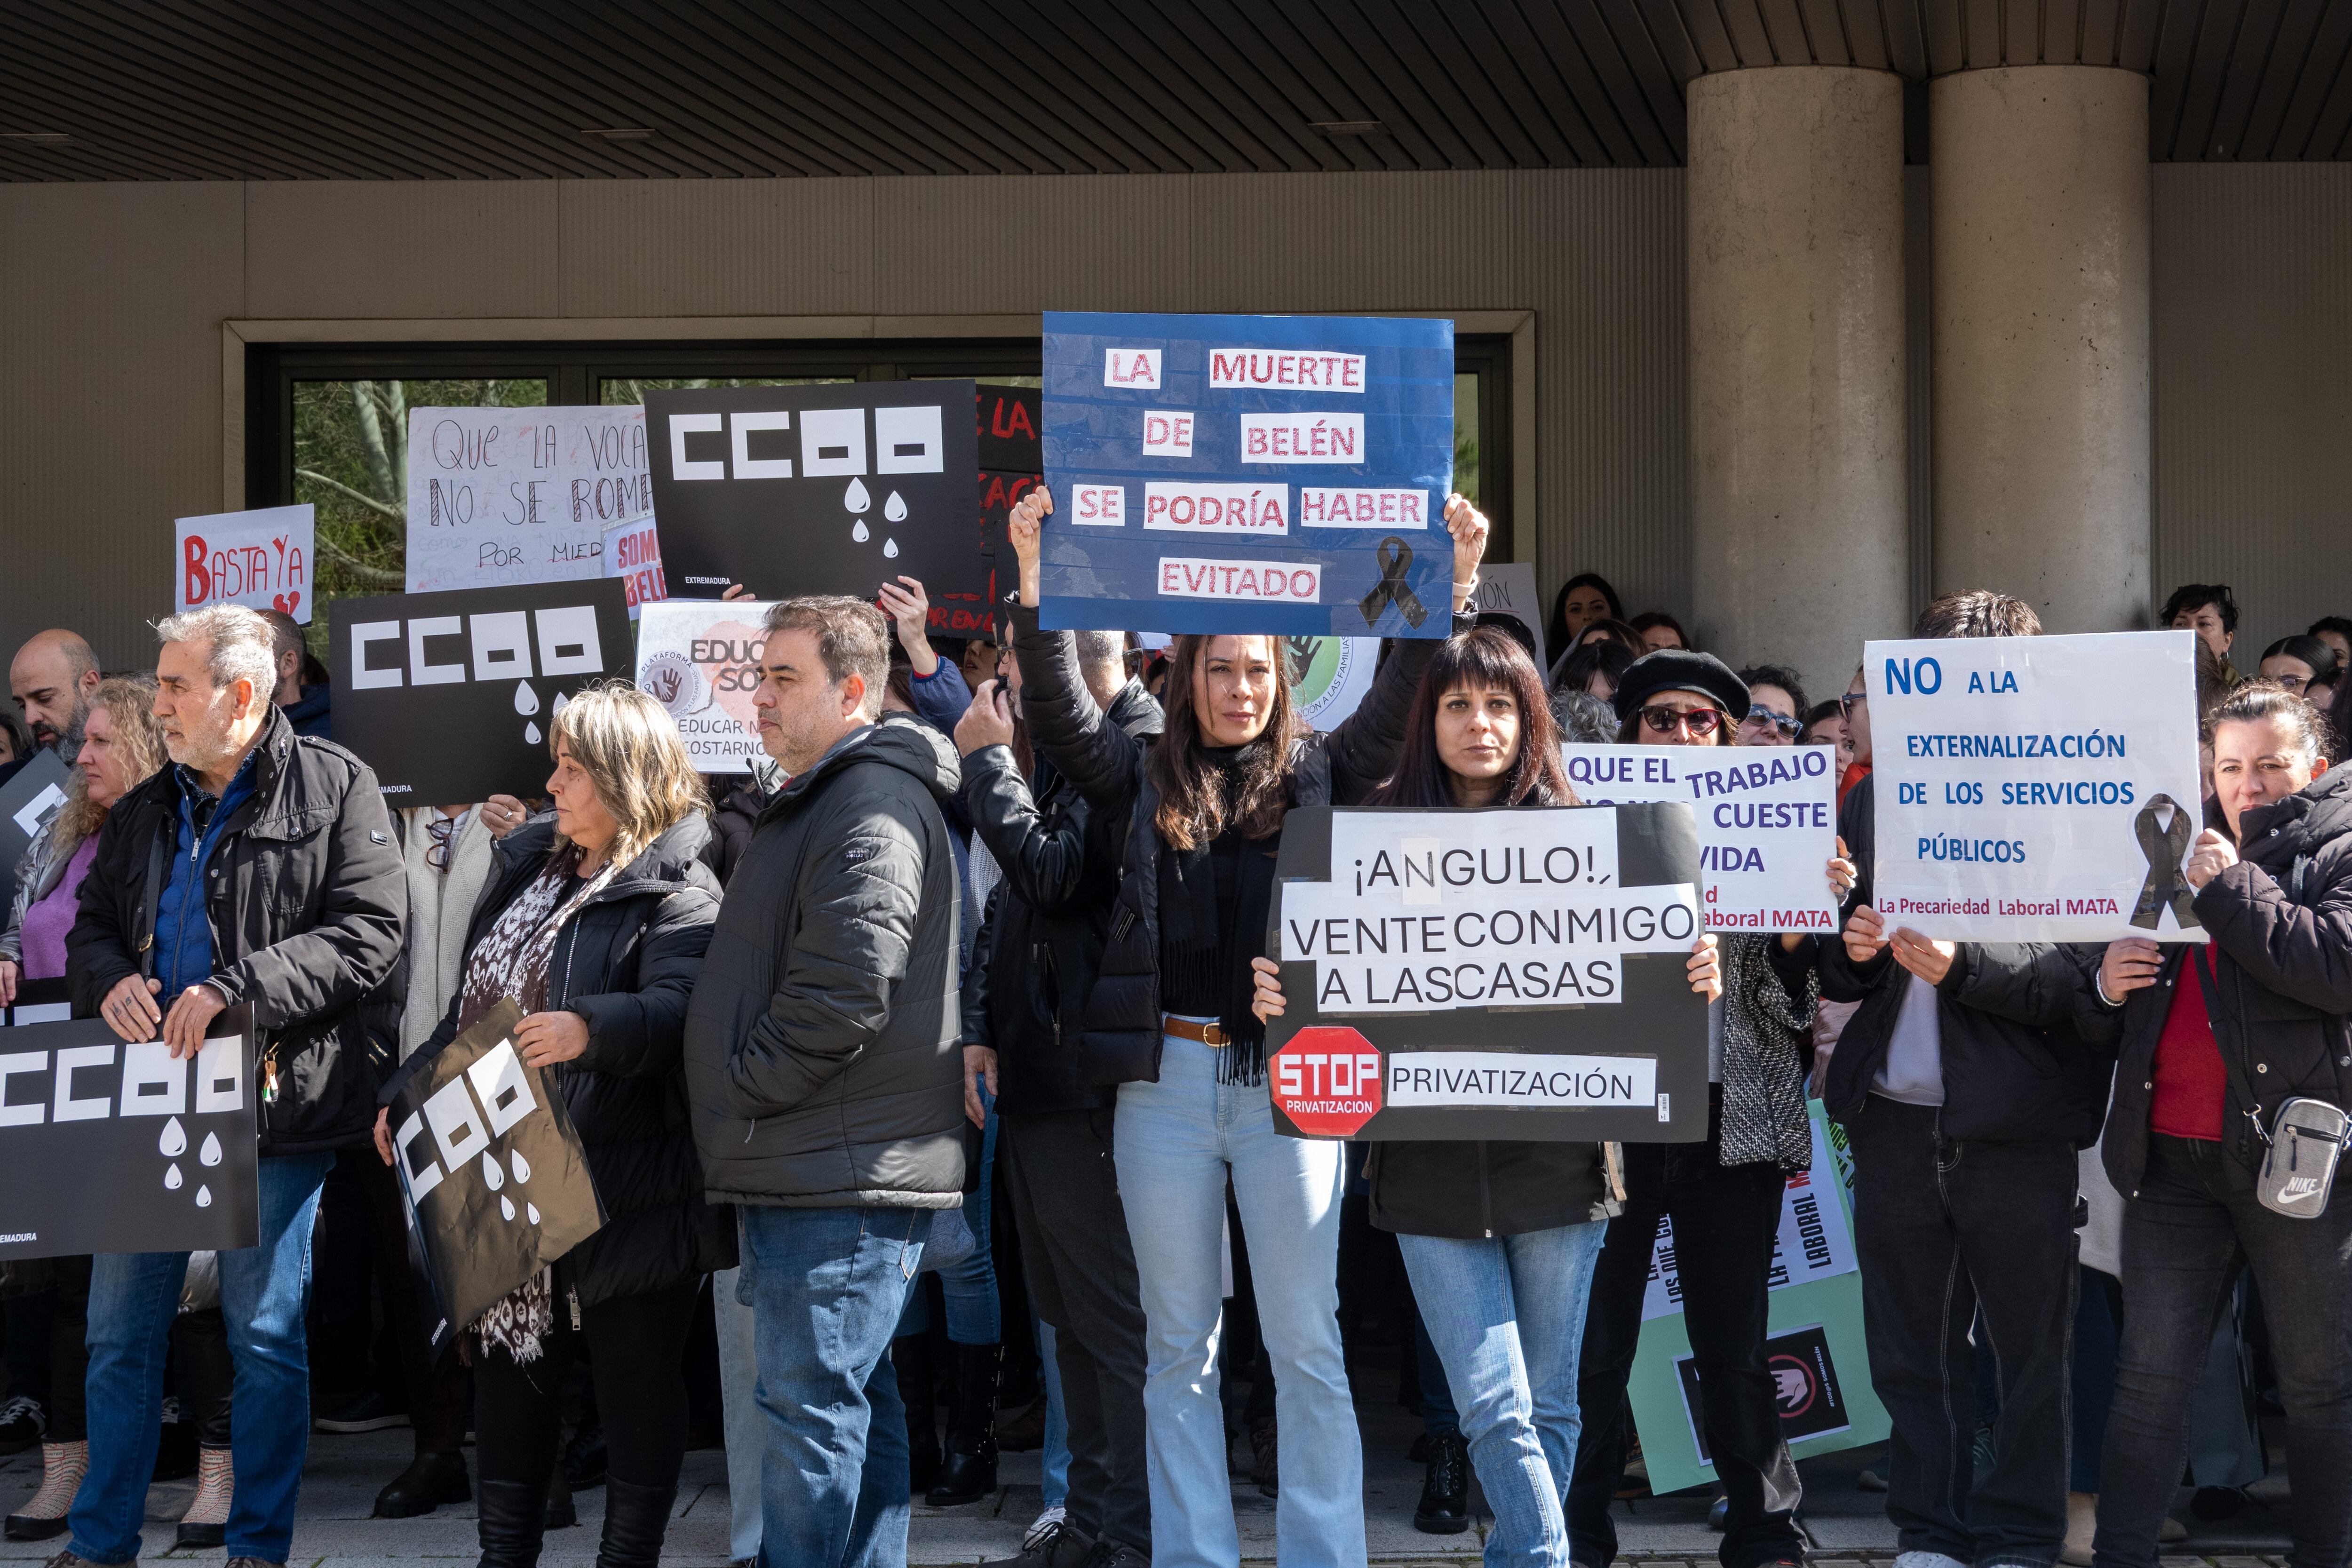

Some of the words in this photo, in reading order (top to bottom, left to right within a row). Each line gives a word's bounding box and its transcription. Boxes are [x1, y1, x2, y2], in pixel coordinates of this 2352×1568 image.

[1112, 353, 1154, 383] LA
[1213, 353, 1360, 386] MUERTE
[534, 425, 556, 469] LA
[1146, 417, 1192, 446] DE
[1248, 420, 1354, 456] BELÉN
[430, 478, 473, 526] NO
[503, 480, 547, 525] SE
[1080, 490, 1119, 518] SE
[1148, 490, 1285, 528] PODRÍA
[1303, 492, 1421, 523] HABER
[479, 542, 524, 568] POR
[618, 528, 661, 569] SOM
[184, 535, 268, 605] BASTA
[272, 534, 303, 589] YA
[685, 577, 731, 585] EXTREMADURA
[1162, 563, 1317, 598] EVITADO
[641, 652, 693, 673] PLATAFORMA
[1327, 679, 1341, 698] LAS
[1337, 636, 1350, 679] FAMILIAS
[1885, 657, 1942, 695] NO
[1968, 671, 1985, 694] A
[1990, 671, 2019, 694] LA
[678, 719, 743, 734] EDUCAR
[1907, 729, 2125, 758] EXTERNALIZACIÓN
[1568, 756, 1633, 786] QUE
[1644, 758, 1676, 783] EL
[1685, 751, 1827, 799] TRABAJO
[1899, 782, 1927, 805] DE
[1946, 782, 1983, 805] LOS
[2002, 781, 2135, 805] SERVICIOS
[1713, 802, 1828, 828] CUESTE
[1918, 832, 2026, 863] PÚBLICOS
[1772, 910, 1833, 928] MATA
[1879, 898, 1895, 914] La
[1900, 897, 1990, 915] Precariedad
[1998, 899, 2060, 915] Laboral
[2066, 899, 2119, 915] MATA
[1289, 915, 1447, 956] VENTE
[1454, 903, 1694, 947] CONMIGO
[1319, 968, 1351, 1005] A
[1368, 965, 1453, 1004] LAS
[1455, 960, 1615, 1001] CASAS
[1279, 1054, 1380, 1097] STOP
[1393, 1067, 1632, 1100] PRIVATIZACIÓN
[1287, 1099, 1373, 1114] PRIVATIZACION
[392, 1037, 537, 1231] COO
[2286, 1176, 2318, 1193] NIKE
[1792, 1192, 1832, 1270] LABORAL
[1814, 1346, 1823, 1362] BELÉN
[1819, 1362, 1828, 1382] SOMOS
[1824, 1382, 1835, 1408] #TOD@S
